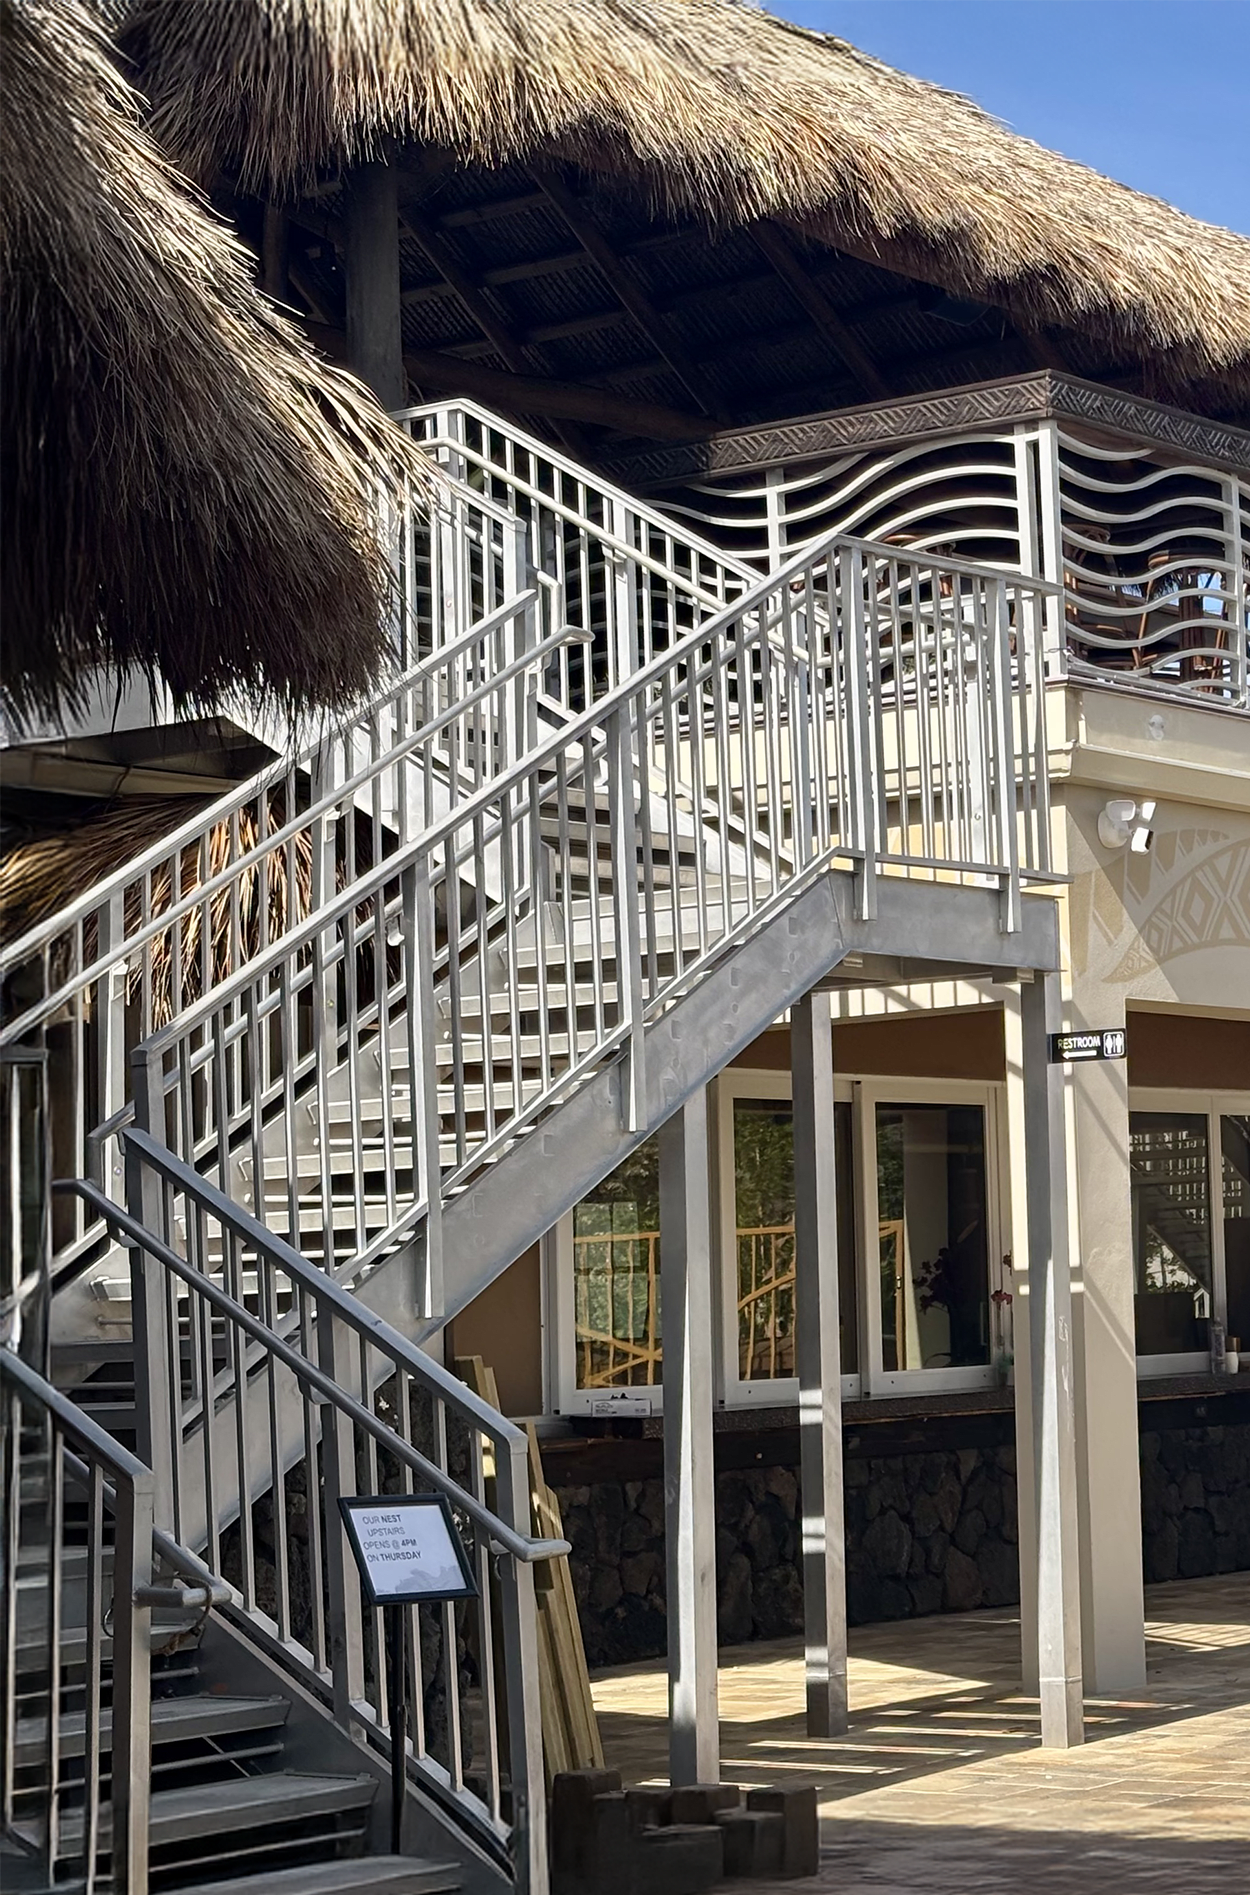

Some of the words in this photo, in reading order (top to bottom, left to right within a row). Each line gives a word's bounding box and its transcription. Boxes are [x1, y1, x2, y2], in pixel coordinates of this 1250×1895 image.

[1057, 1035, 1101, 1050] RESTROOM
[362, 1515, 380, 1525] OUR
[381, 1514, 402, 1524] NEST
[367, 1526, 406, 1537] UPSTAIRS
[363, 1540, 391, 1550] OPENS
[401, 1538, 417, 1547] 4PM
[367, 1553, 379, 1563] ON
[380, 1550, 421, 1561] THURSDAY
